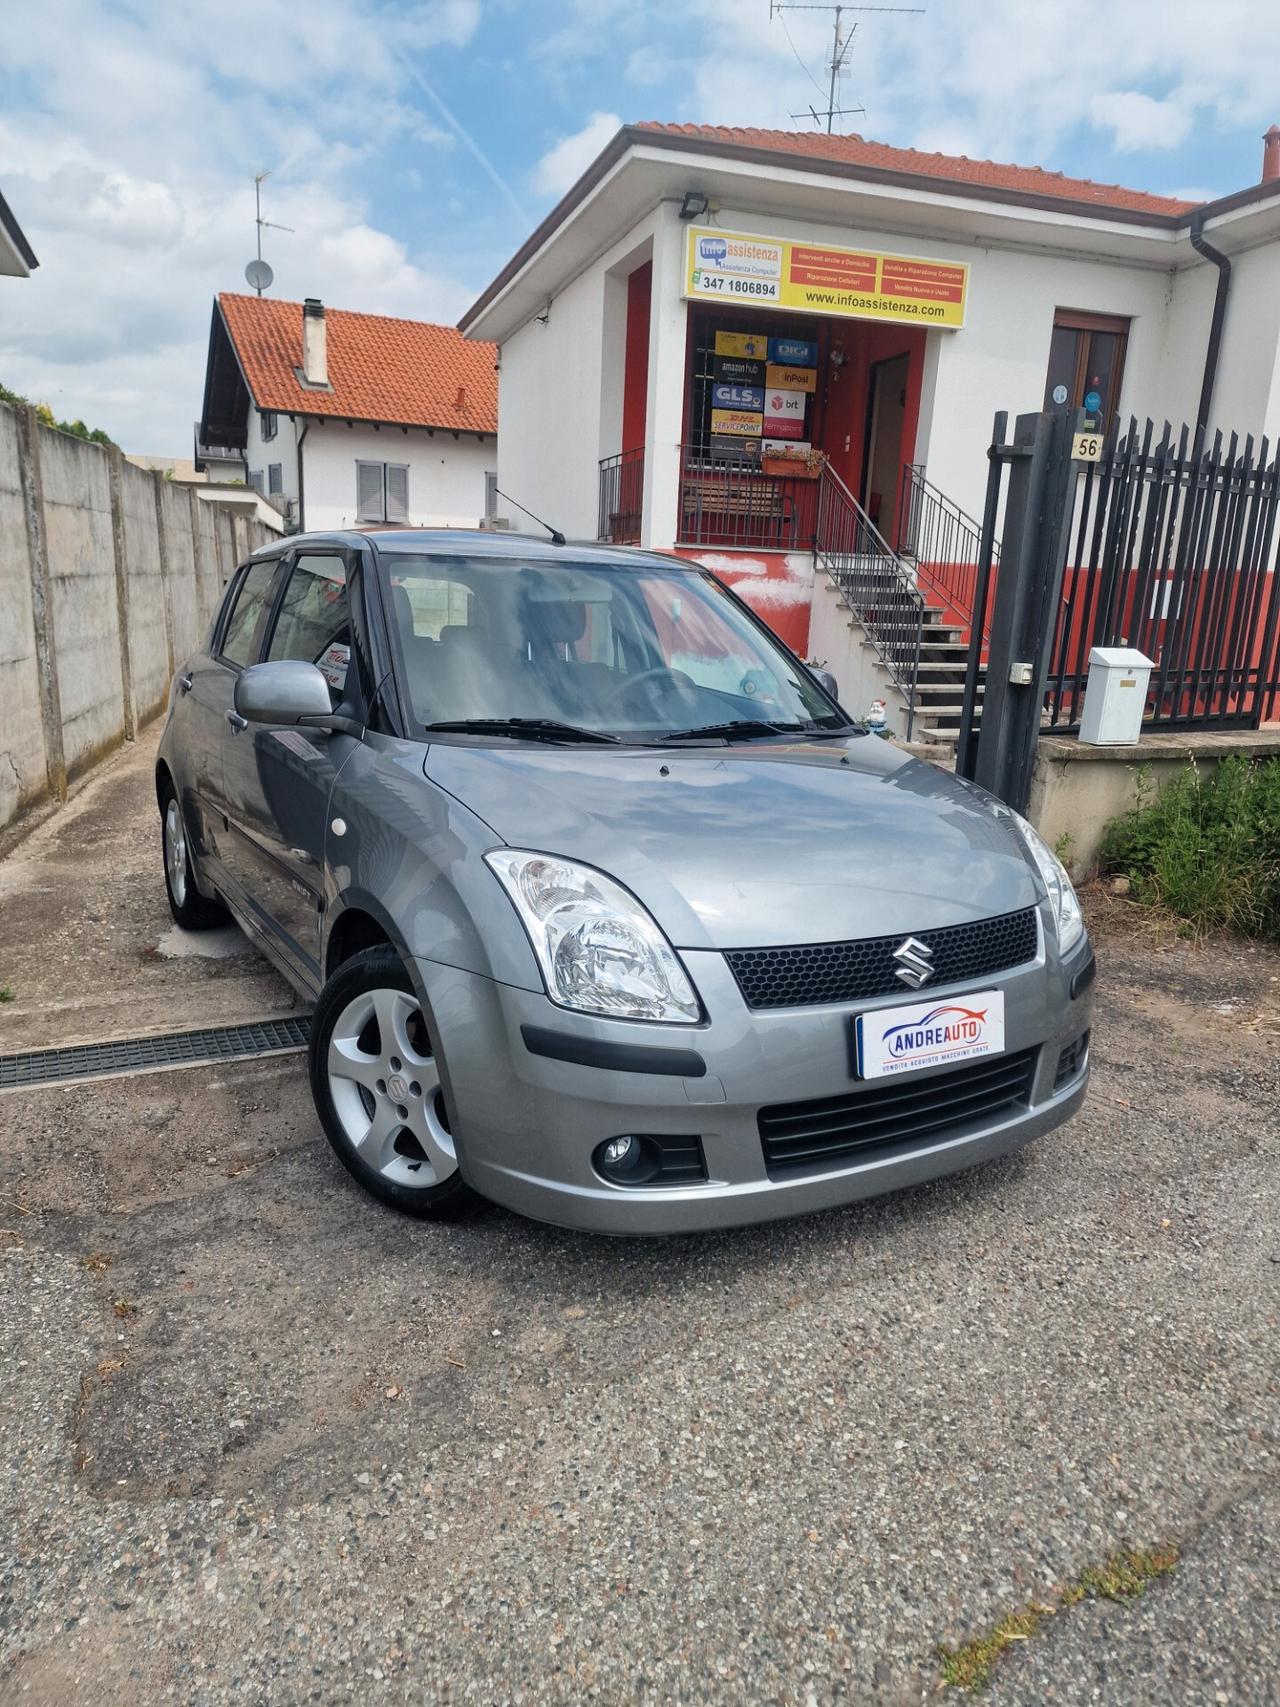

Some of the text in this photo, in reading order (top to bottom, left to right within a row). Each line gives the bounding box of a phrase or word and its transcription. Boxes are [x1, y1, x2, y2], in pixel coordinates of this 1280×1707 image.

[728, 243, 778, 262] assistenza
[722, 263, 777, 276] Assistenza Computer
[806, 272, 860, 285] Riparazione Cellulari
[704, 277, 776, 296] 347 1806894
[806, 292, 945, 317] www.infoassistenza.com
[722, 362, 759, 375] amazon hub
[784, 374, 809, 383] InPost
[716, 387, 753, 402] GLS
[786, 400, 799, 409] brt
[729, 414, 756, 423] DHL
[1079, 439, 1097, 456] 56
[894, 1020, 978, 1052] ANDREAUTO
[882, 1062, 908, 1072] VENDITA
[910, 1056, 939, 1067] ACQUISTO
[941, 1050, 970, 1061] MACCHINE
